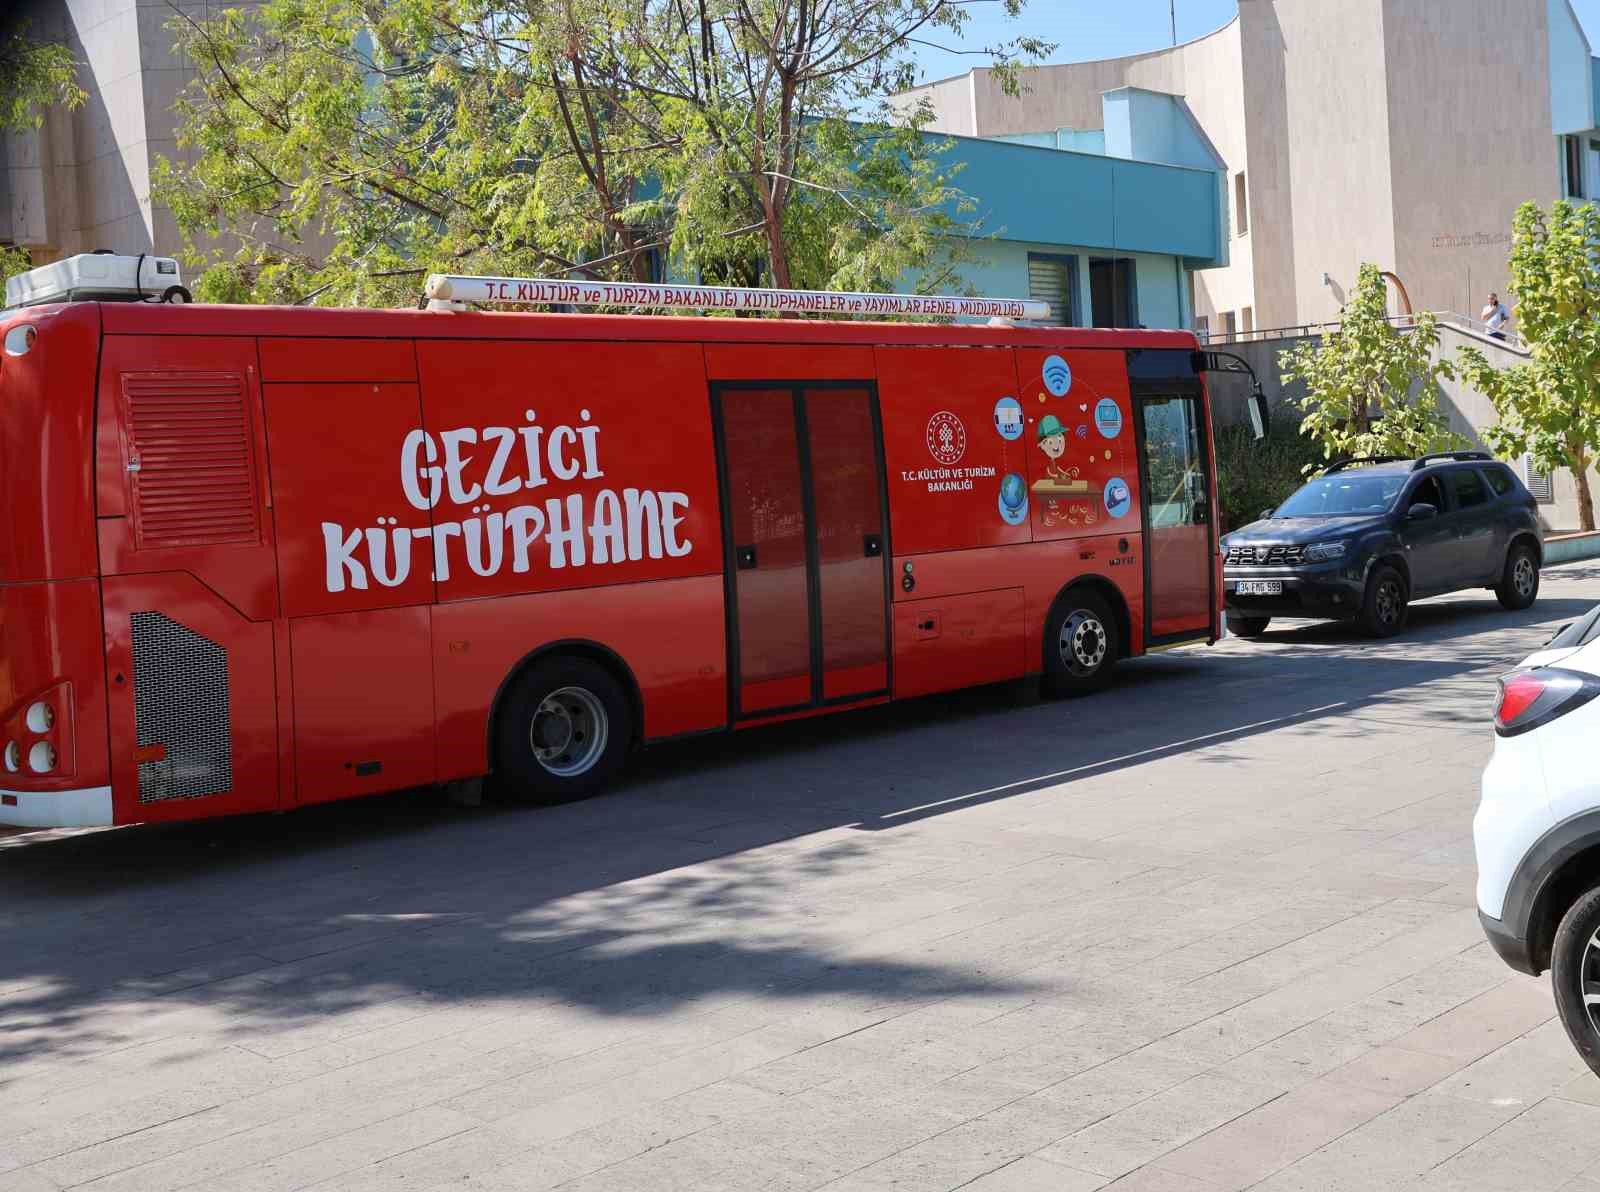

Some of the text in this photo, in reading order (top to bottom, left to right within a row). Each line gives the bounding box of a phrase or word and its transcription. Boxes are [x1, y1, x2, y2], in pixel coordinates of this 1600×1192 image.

[485, 282, 512, 300] T.C.
[584, 290, 601, 303] ve
[848, 300, 862, 311] ve
[863, 296, 921, 313] YAYIMLAR
[923, 299, 957, 315] GENEL
[400, 408, 604, 511] GEZİCİ
[918, 468, 950, 480] KÜLTÜR
[952, 469, 963, 478] VE
[964, 466, 995, 477] TURİZM
[928, 480, 973, 492] BAKANLIĞI
[321, 488, 693, 592] KÜTÜPHANE
